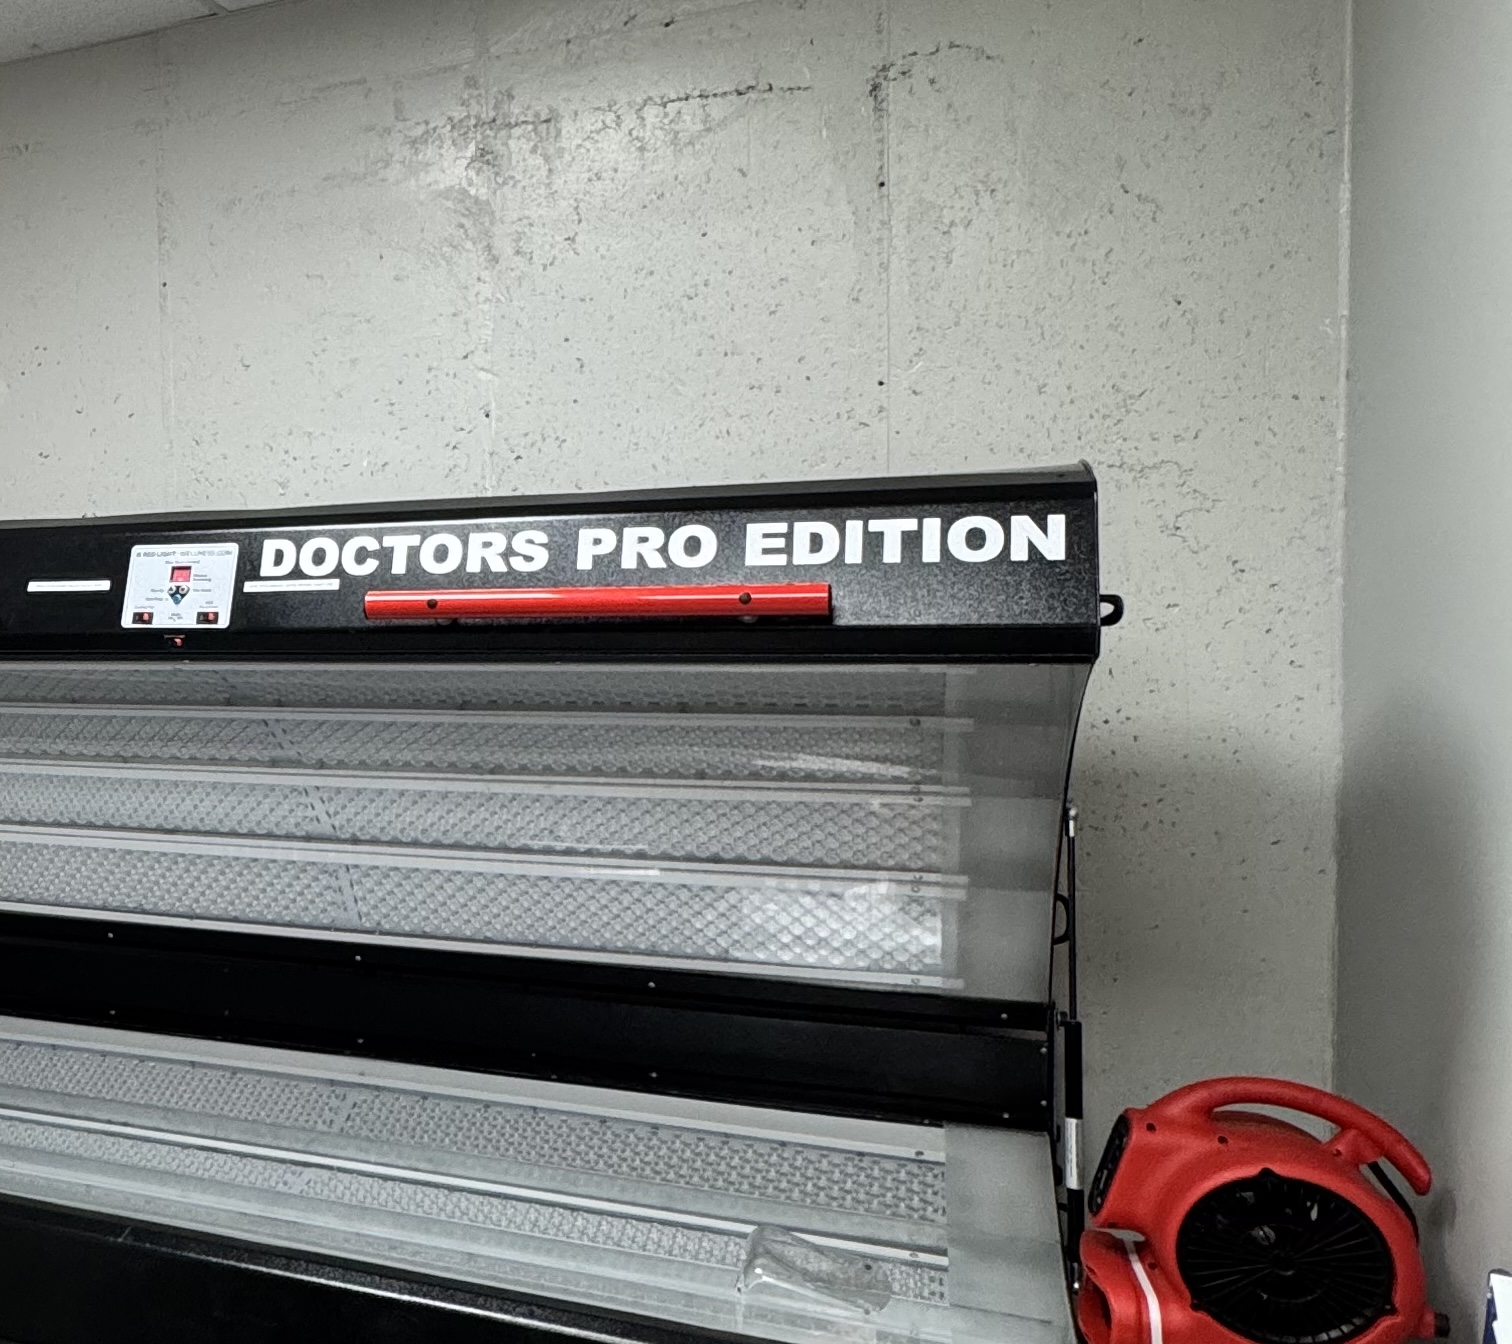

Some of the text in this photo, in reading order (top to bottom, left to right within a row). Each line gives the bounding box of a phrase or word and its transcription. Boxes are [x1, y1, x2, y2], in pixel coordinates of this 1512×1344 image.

[259, 513, 1067, 577] DOCTORS PRO EDITION
